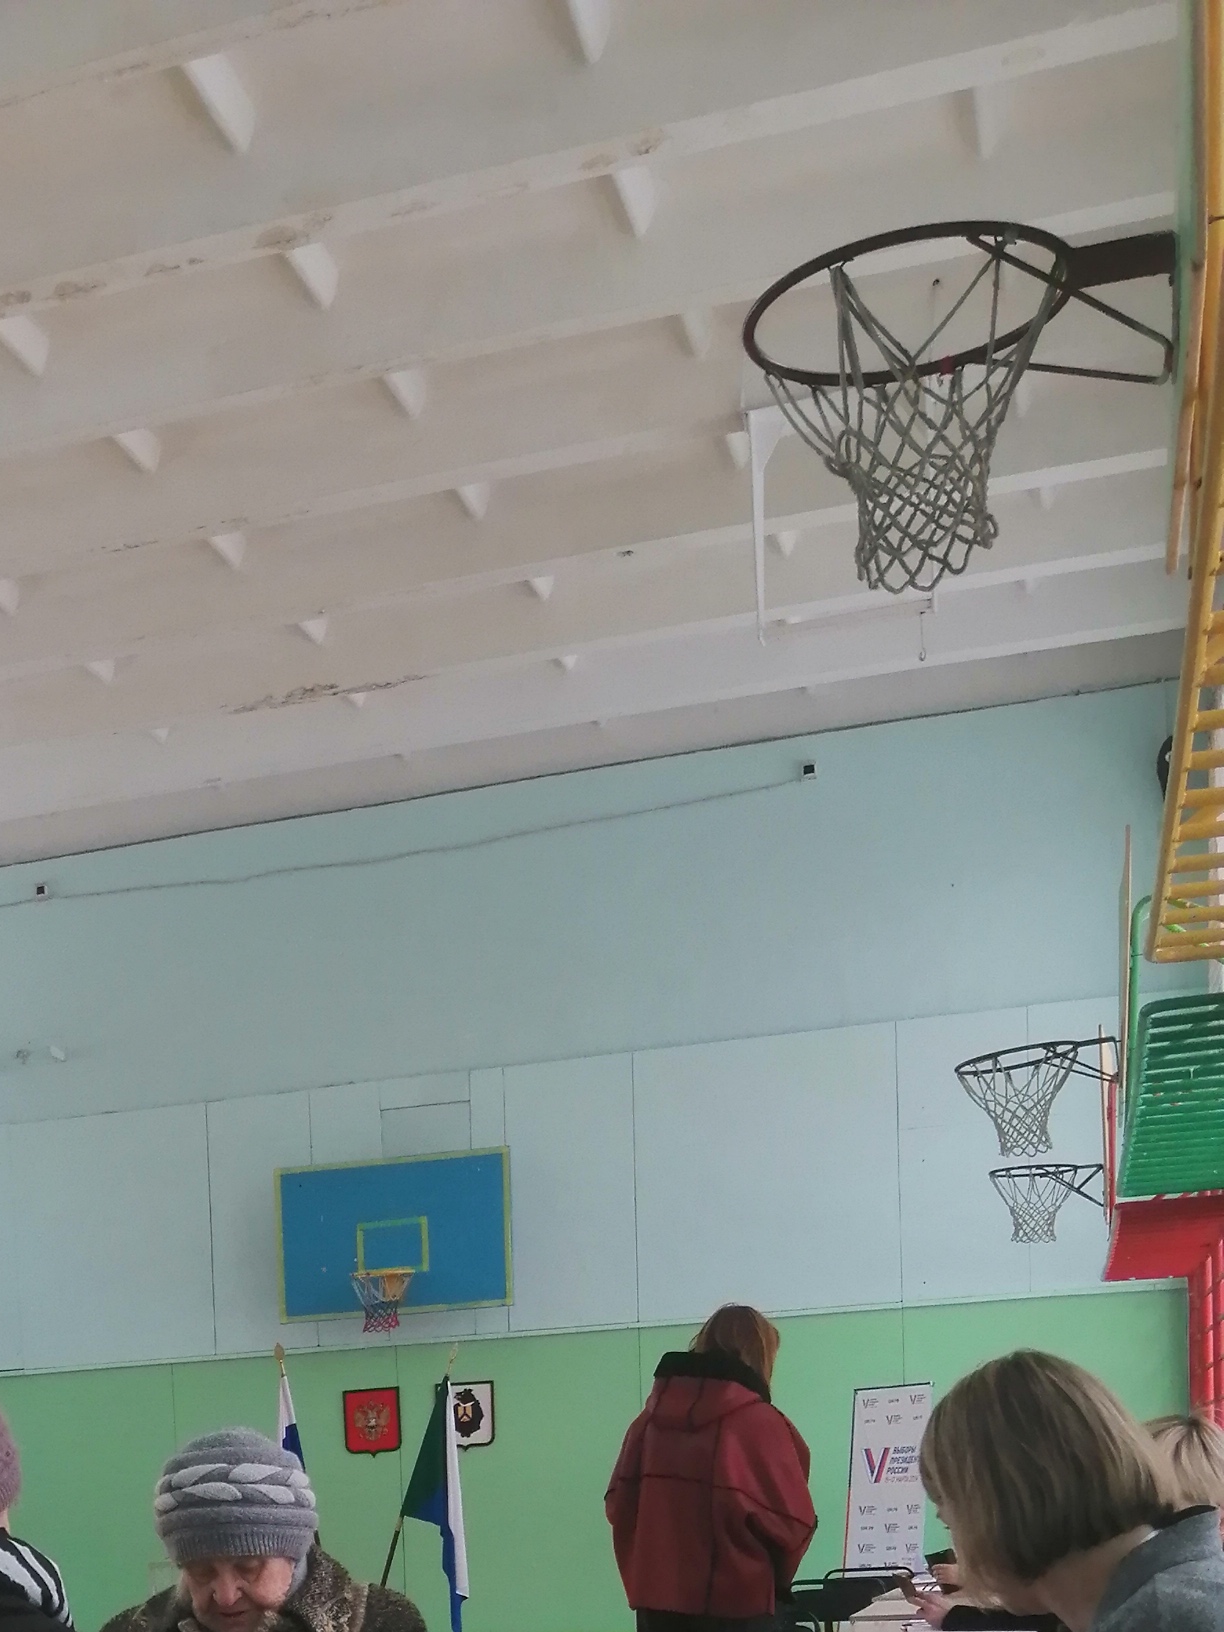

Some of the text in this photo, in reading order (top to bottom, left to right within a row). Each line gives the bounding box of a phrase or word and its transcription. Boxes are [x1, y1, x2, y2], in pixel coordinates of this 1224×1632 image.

[892, 1446, 916, 1454] ВЫБОРЫ
[889, 1456, 921, 1464] ПРЕЗИДЕН
[861, 1447, 891, 1484] V
[886, 1466, 909, 1475] РОССИИ
